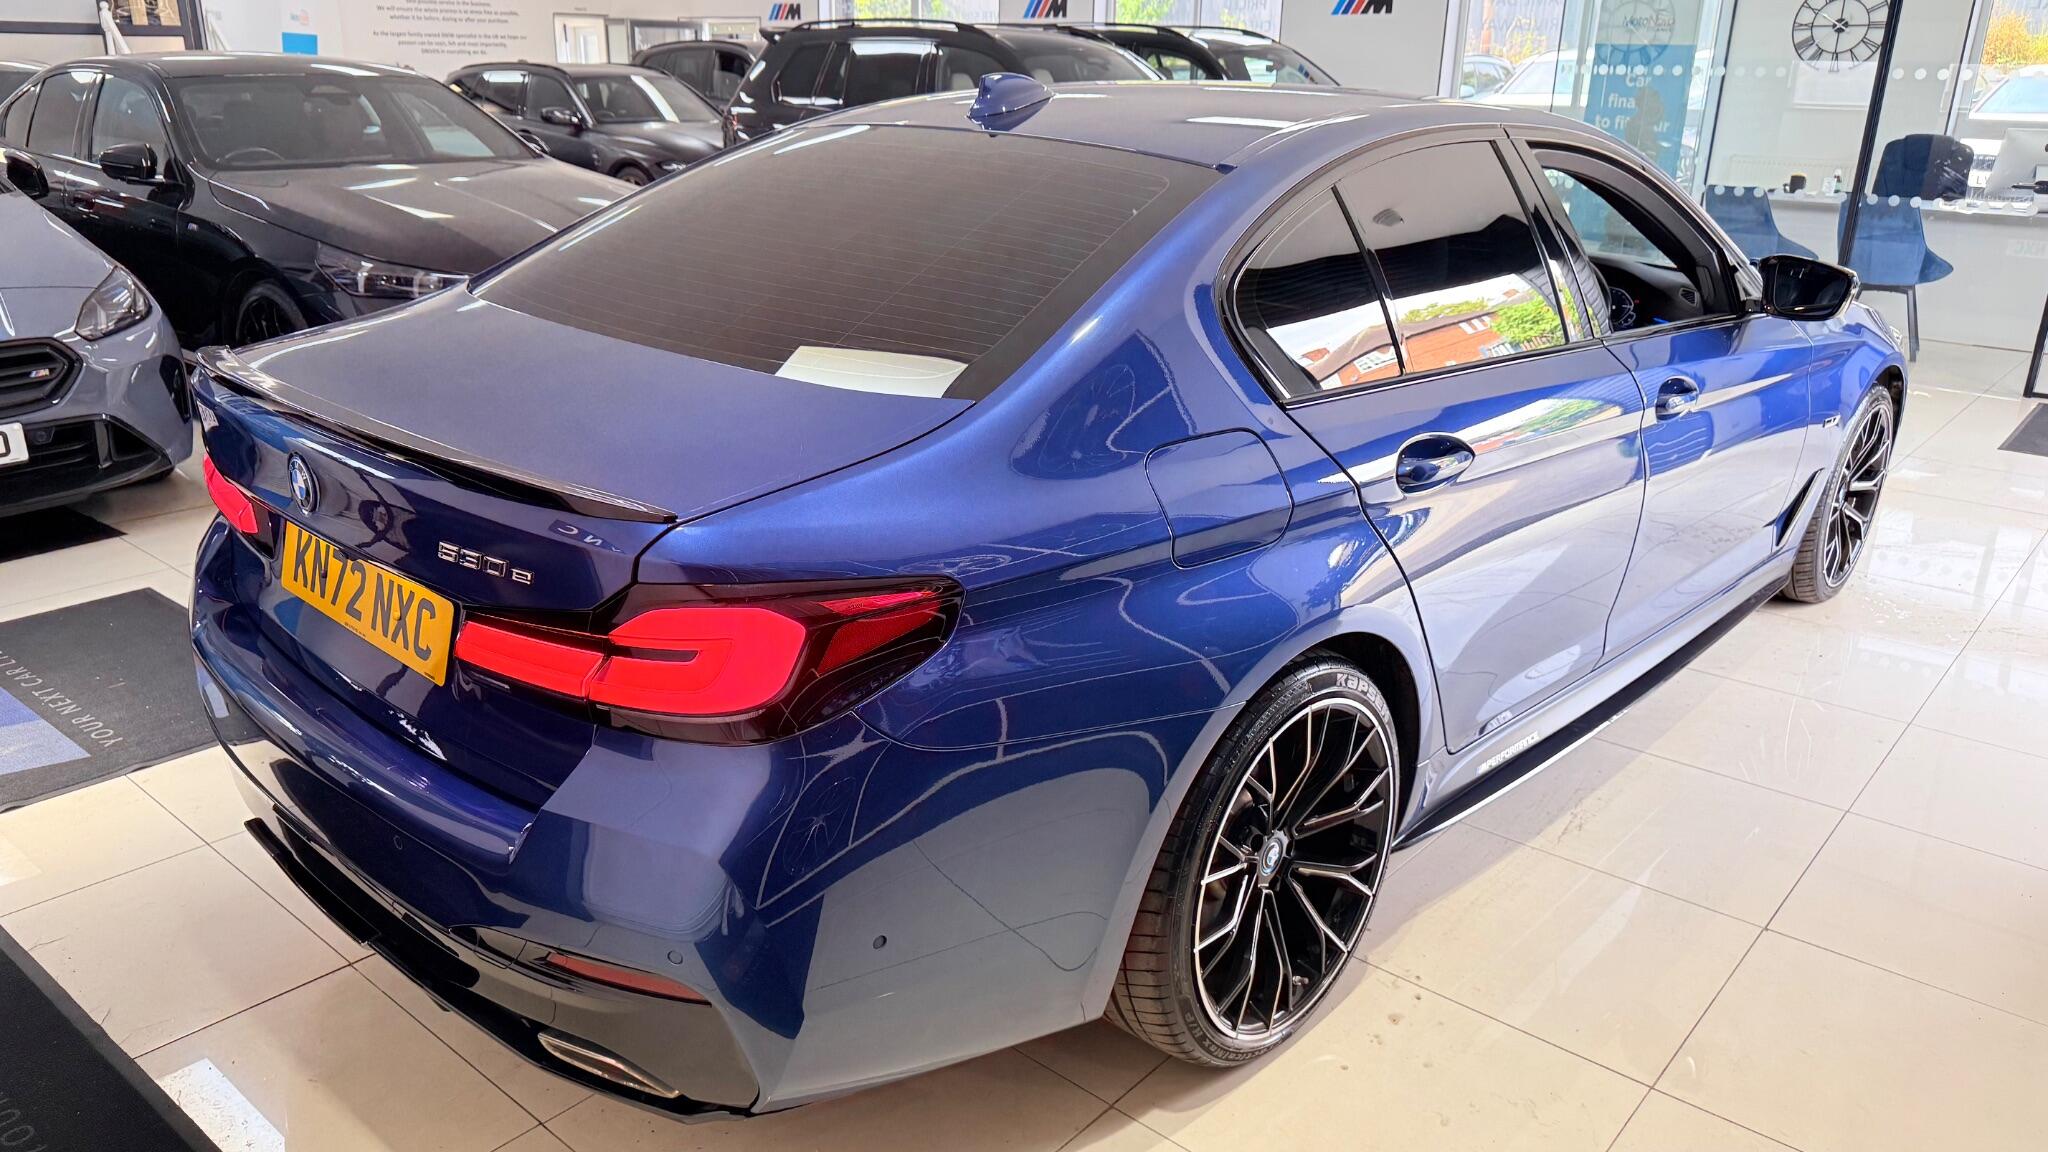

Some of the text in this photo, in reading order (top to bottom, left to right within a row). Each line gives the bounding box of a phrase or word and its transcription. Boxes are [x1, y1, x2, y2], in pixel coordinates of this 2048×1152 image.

[293, 529, 436, 661] KN72 NXC
[6, 666, 123, 747] YOUR NEXT CAR
